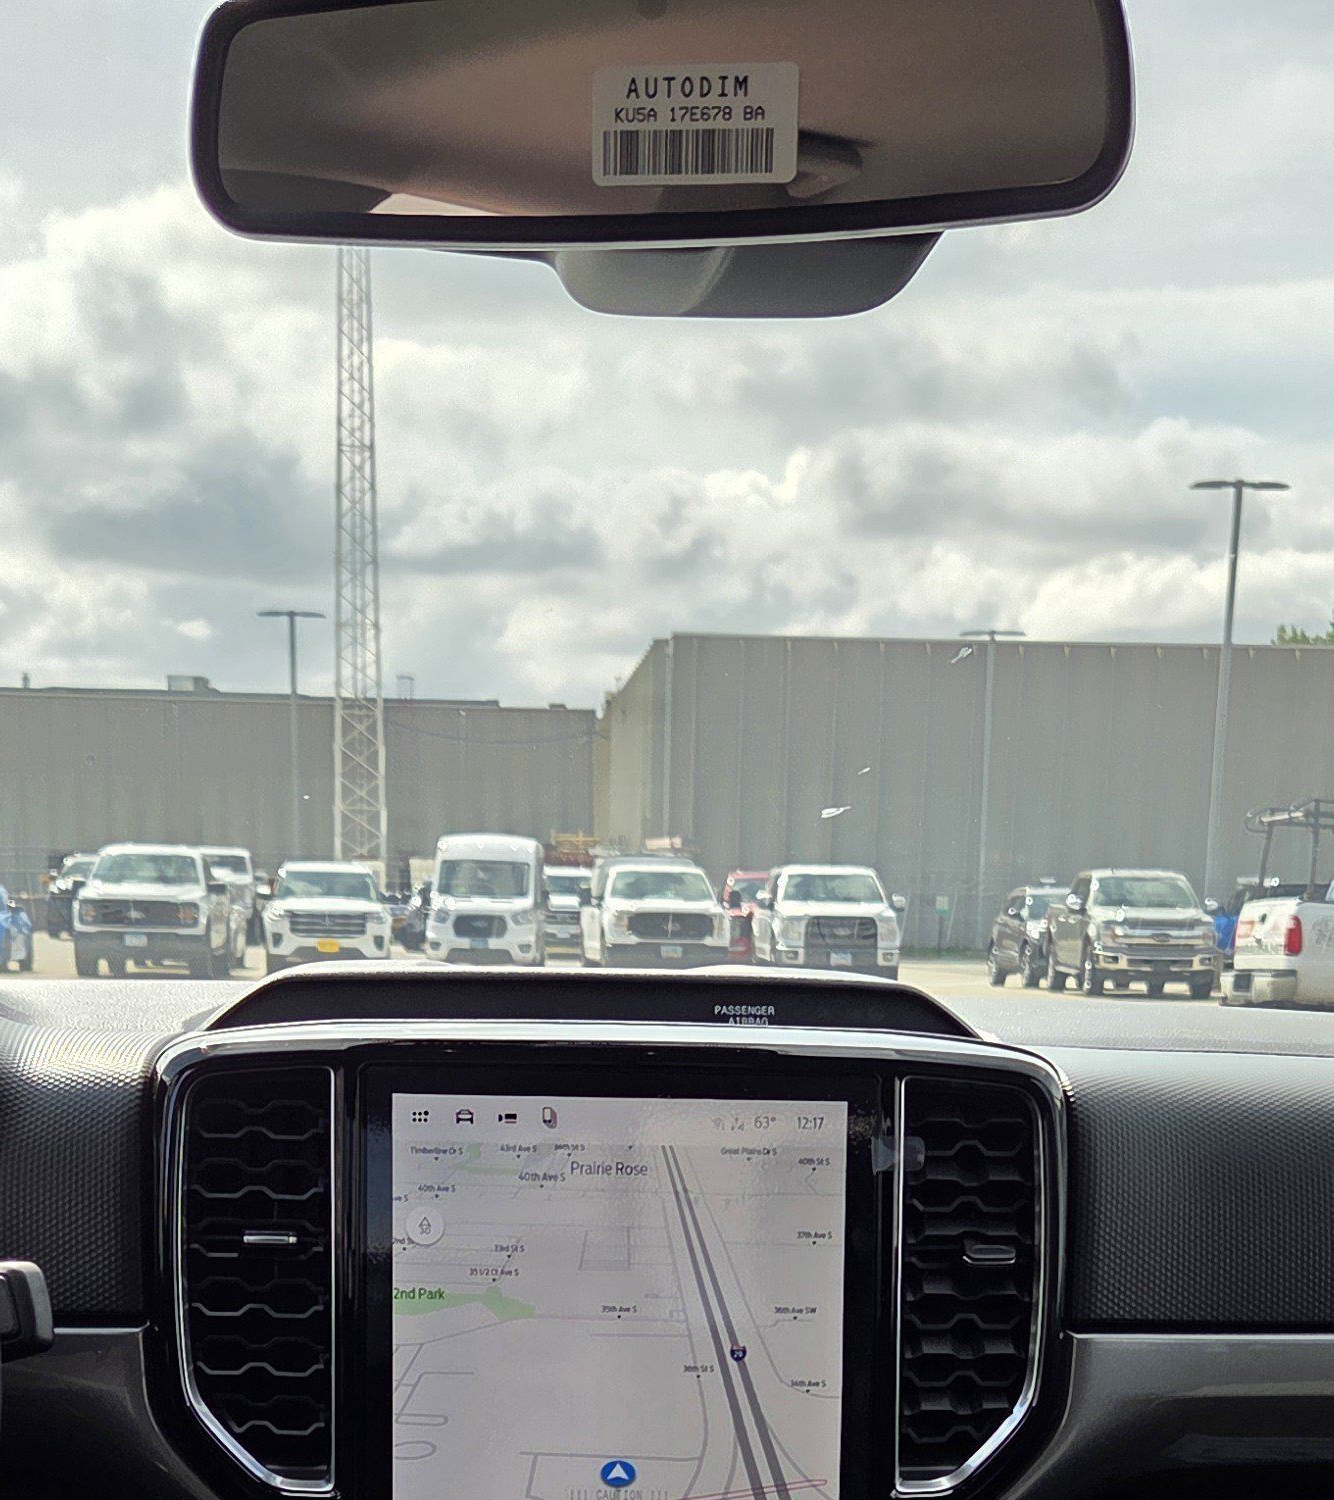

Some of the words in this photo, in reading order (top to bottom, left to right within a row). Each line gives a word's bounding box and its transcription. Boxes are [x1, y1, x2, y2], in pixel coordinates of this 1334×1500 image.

[625, 75, 749, 99] AUTODIM
[614, 107, 657, 123] KU5A
[670, 106, 733, 122] 17E678
[743, 106, 766, 121] BA
[713, 1005, 775, 1016] PASSENGER
[796, 1116, 824, 1130] 12:17
[570, 1161, 612, 1176] Prairie
[616, 1161, 648, 1177] Rose
[518, 1172, 540, 1181] 40th
[541, 1173, 559, 1182] Ave
[560, 1174, 566, 1182] S
[418, 1287, 445, 1300] Park
[596, 1488, 643, 1500] CAUTION
